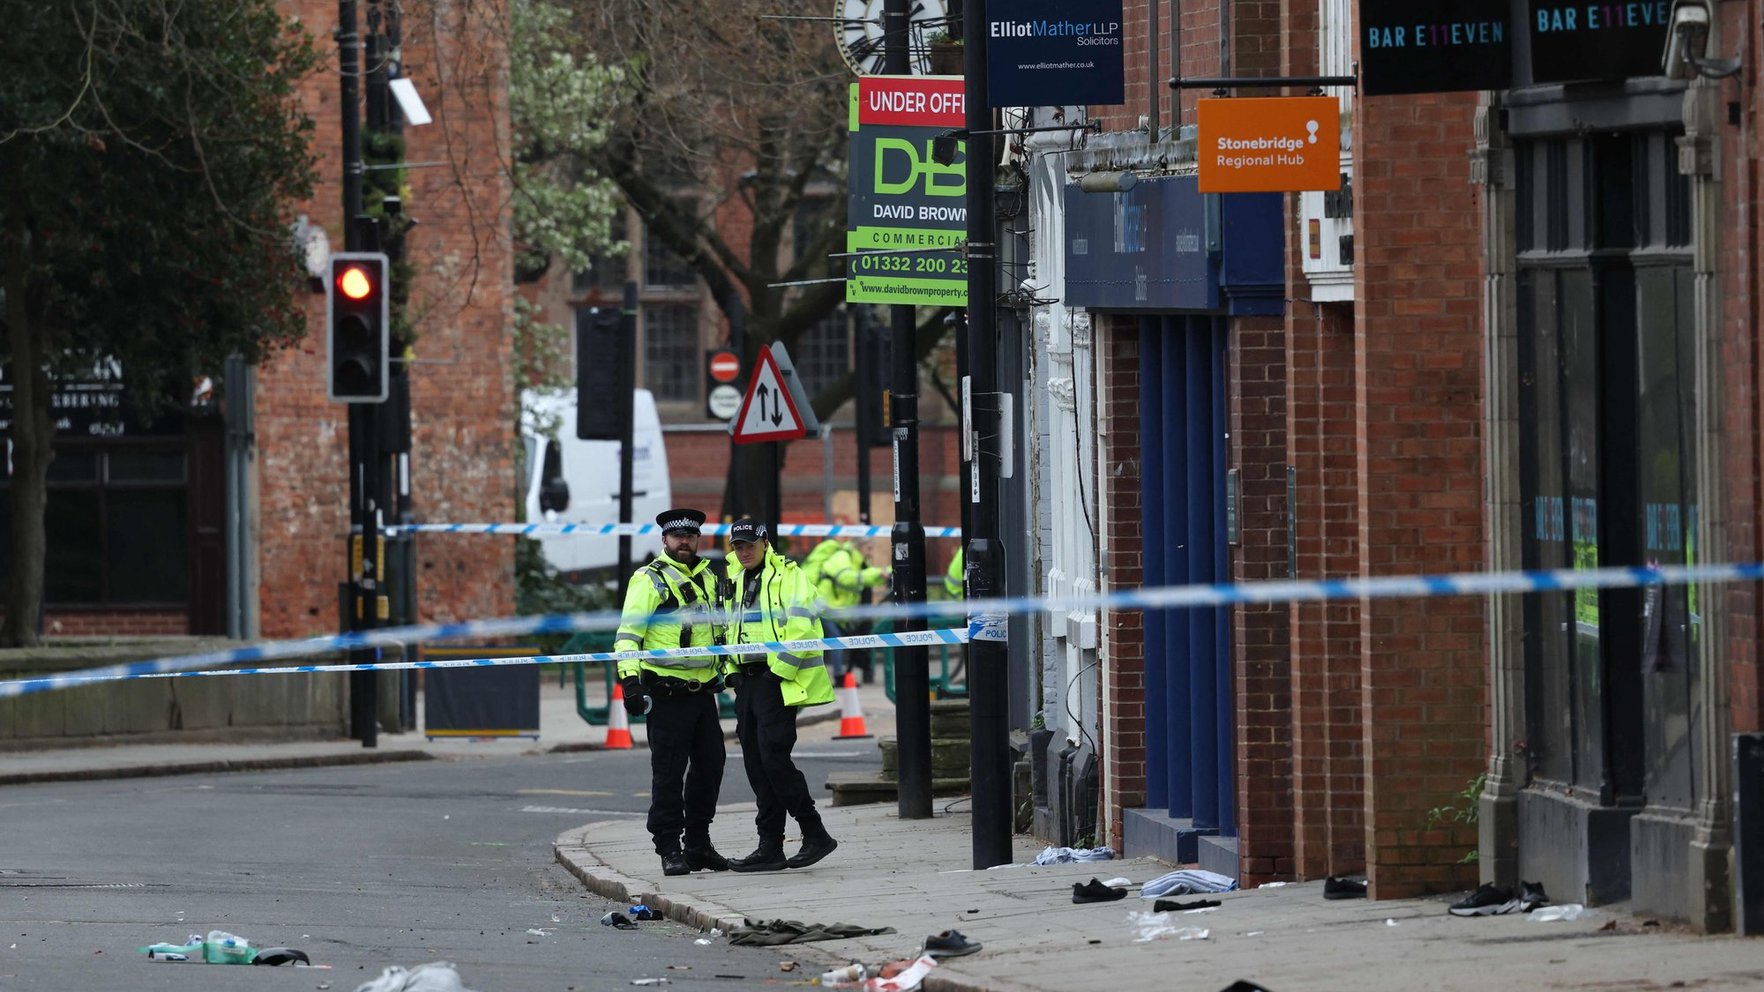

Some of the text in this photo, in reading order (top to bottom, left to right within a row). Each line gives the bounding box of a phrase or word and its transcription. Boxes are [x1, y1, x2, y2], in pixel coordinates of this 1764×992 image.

[1537, 3, 1670, 32] BAR E11EVE
[990, 20, 1119, 37] ElliotMather LLP
[1369, 21, 1503, 48] BAR E11EVEN
[1077, 36, 1119, 46] Solicitors
[1018, 61, 1094, 70] www.elliotmather.co.uk
[870, 91, 926, 112] UNDER
[1217, 137, 1304, 152] Stonebridge
[1217, 155, 1305, 168] Regional Hub
[873, 204, 914, 219] DAVID
[873, 232, 963, 246] COMMERCIA
[862, 255, 910, 272] 01332
[916, 258, 946, 273] 200
[951, 259, 968, 274] 23
[861, 284, 968, 298] www.davidbrownproperty.c
[733, 524, 753, 532] POLICE
[985, 629, 1007, 638] POLIC
